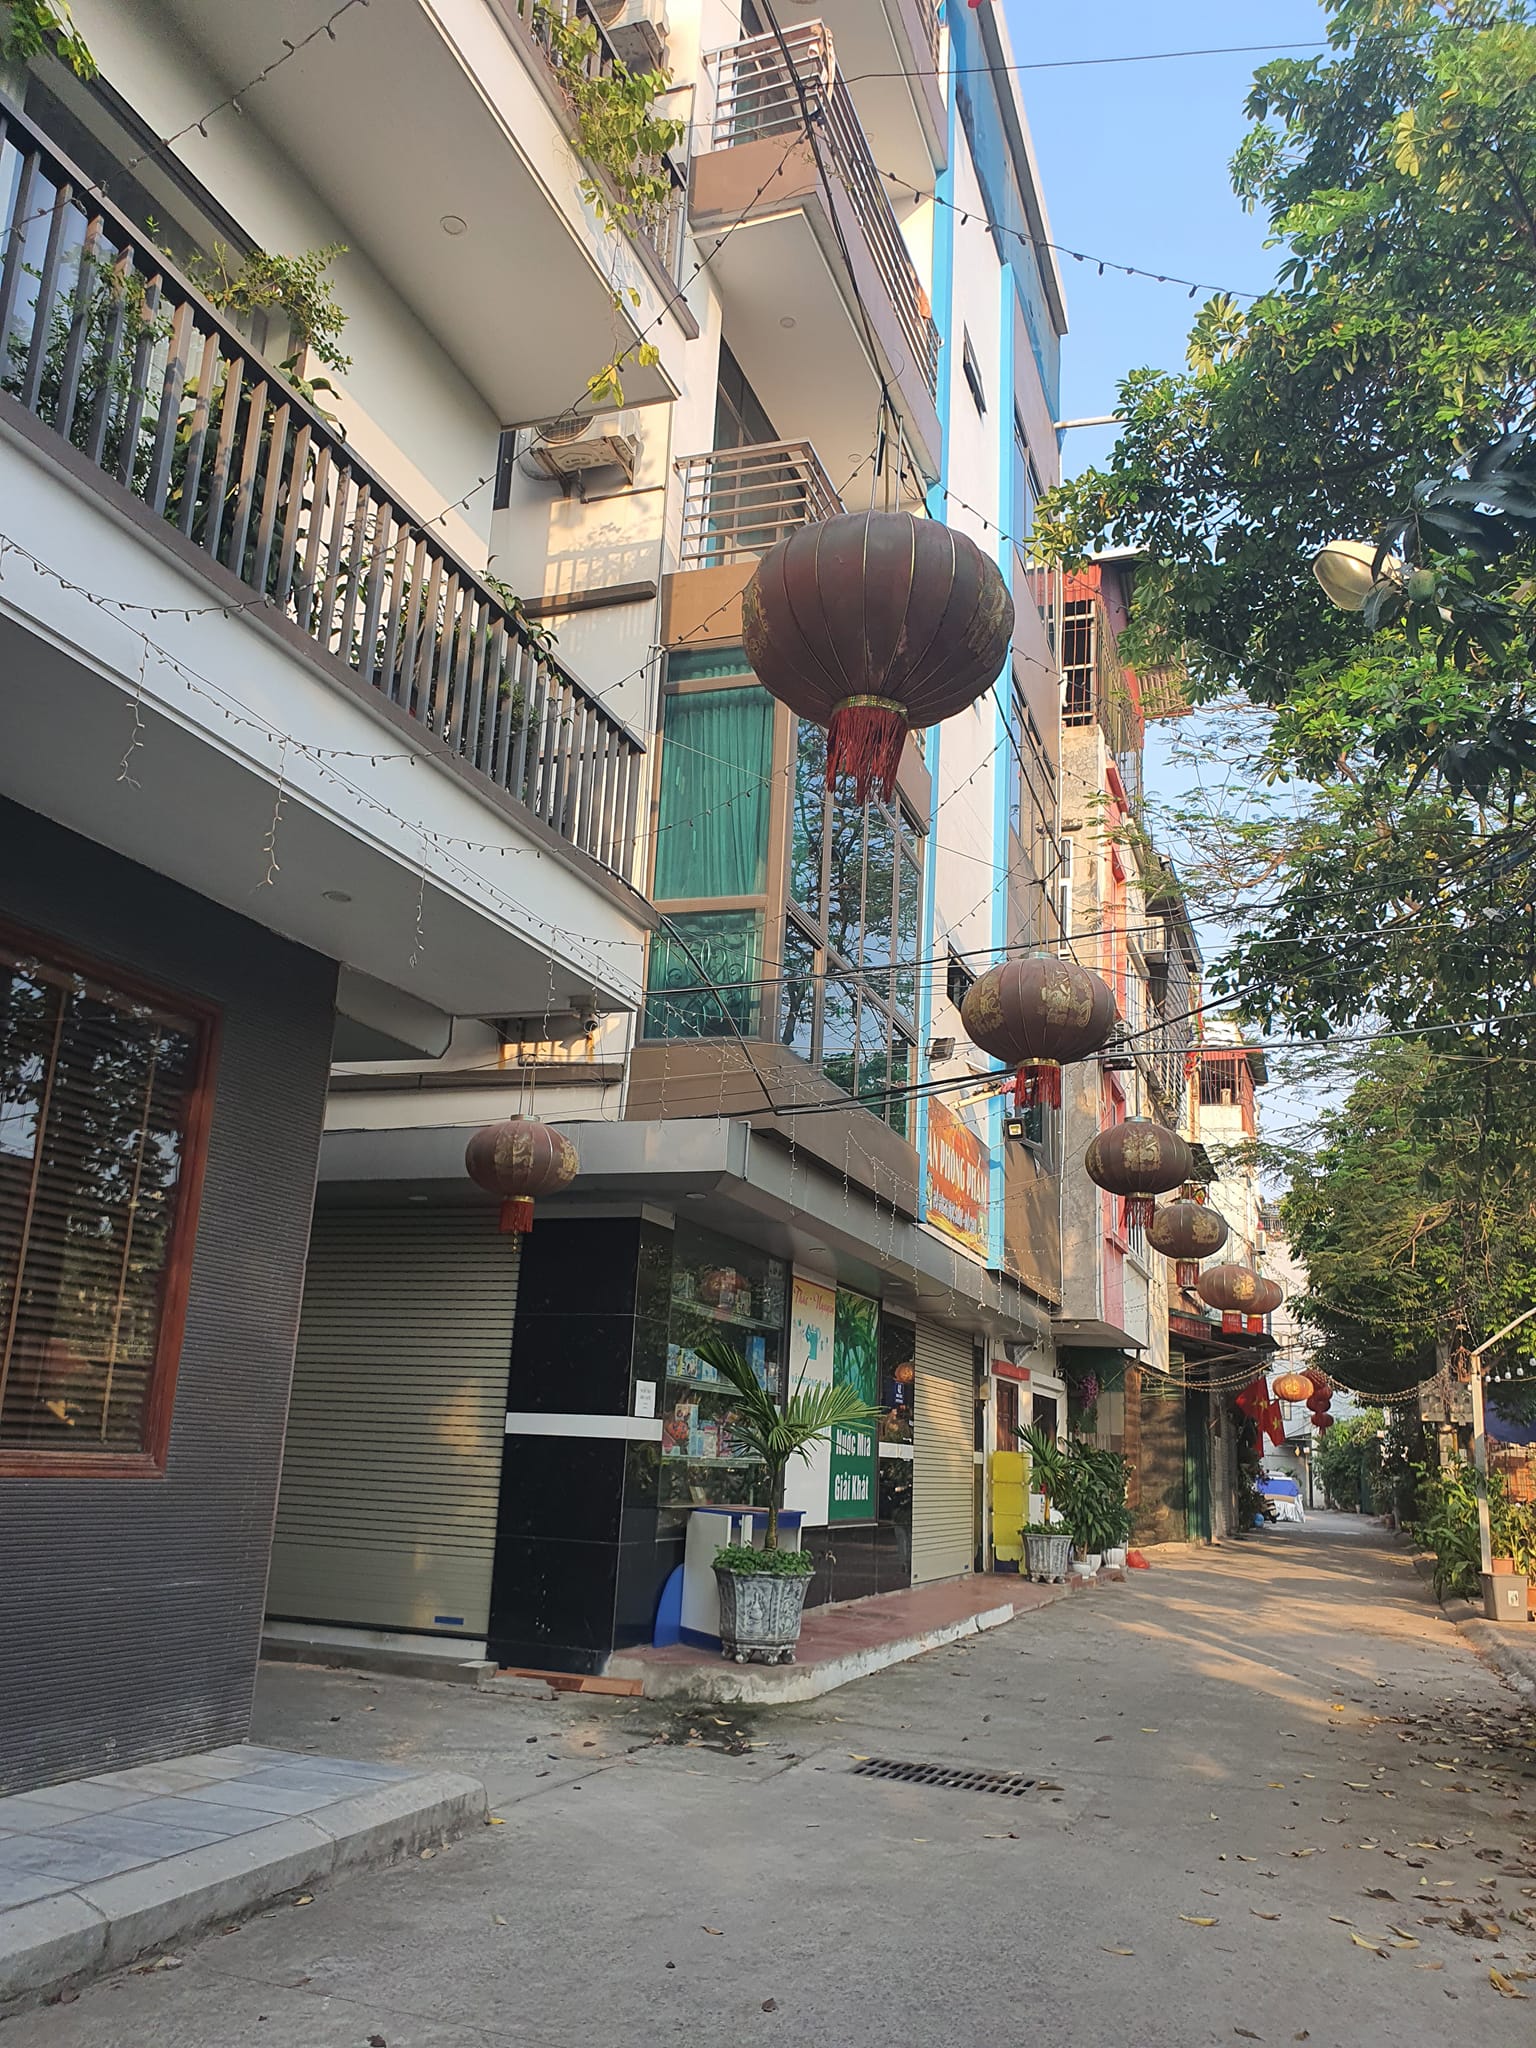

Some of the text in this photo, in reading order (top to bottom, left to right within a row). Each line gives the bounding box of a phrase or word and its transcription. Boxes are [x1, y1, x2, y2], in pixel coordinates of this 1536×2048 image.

[940, 1134, 965, 1192] PHÒNG
[836, 1428, 856, 1456] Nước
[835, 1471, 868, 1501] Giải Khát
